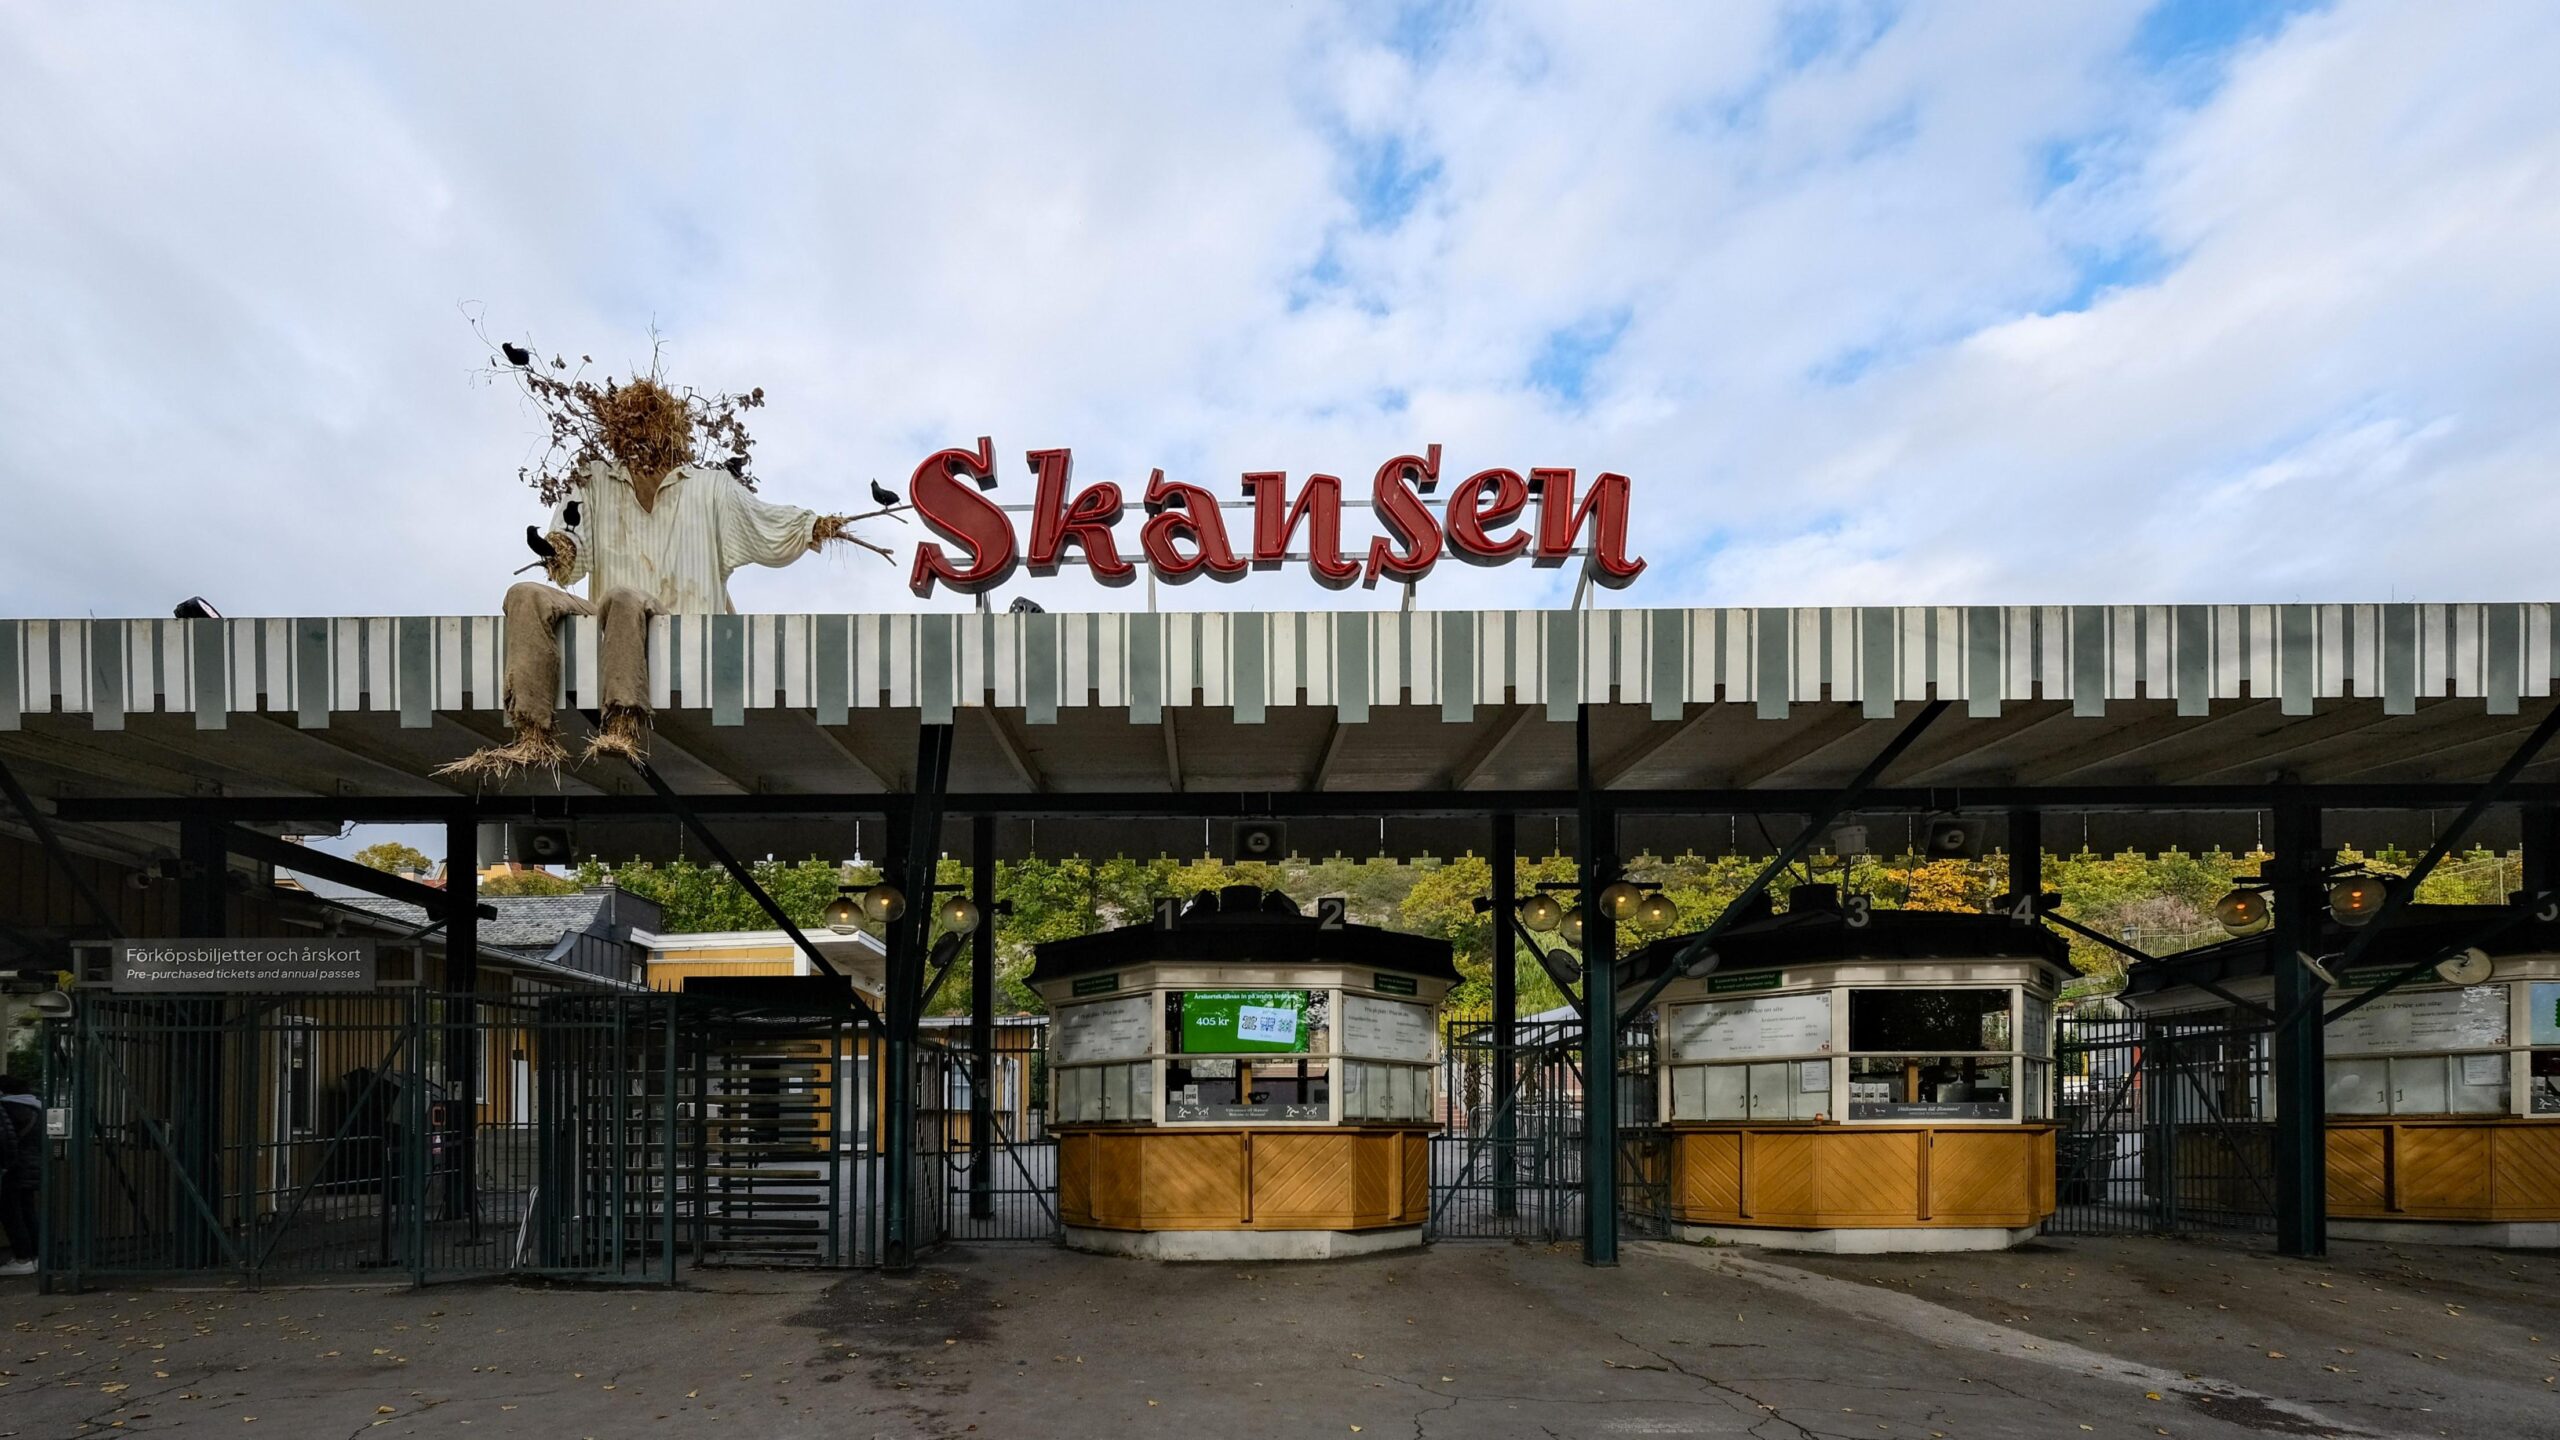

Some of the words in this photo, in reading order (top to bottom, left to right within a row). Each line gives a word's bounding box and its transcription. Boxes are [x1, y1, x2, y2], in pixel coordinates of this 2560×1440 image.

[909, 435, 1647, 600] Skansen
[1156, 900, 1173, 930] 1
[1320, 900, 1343, 930] 2
[1847, 897, 1870, 928] 3
[2011, 895, 2035, 926] 4
[126, 948, 263, 965] Förköpsbiljetter
[266, 948, 298, 962] och
[301, 946, 361, 962] årskort
[126, 968, 214, 980] Pre-purchased
[216, 968, 255, 979] tickets
[257, 969, 279, 979] and
[281, 969, 318, 979] annual
[319, 970, 361, 980] passes
[1196, 1017, 1216, 1026] 405
[1218, 1016, 1230, 1026] kr
